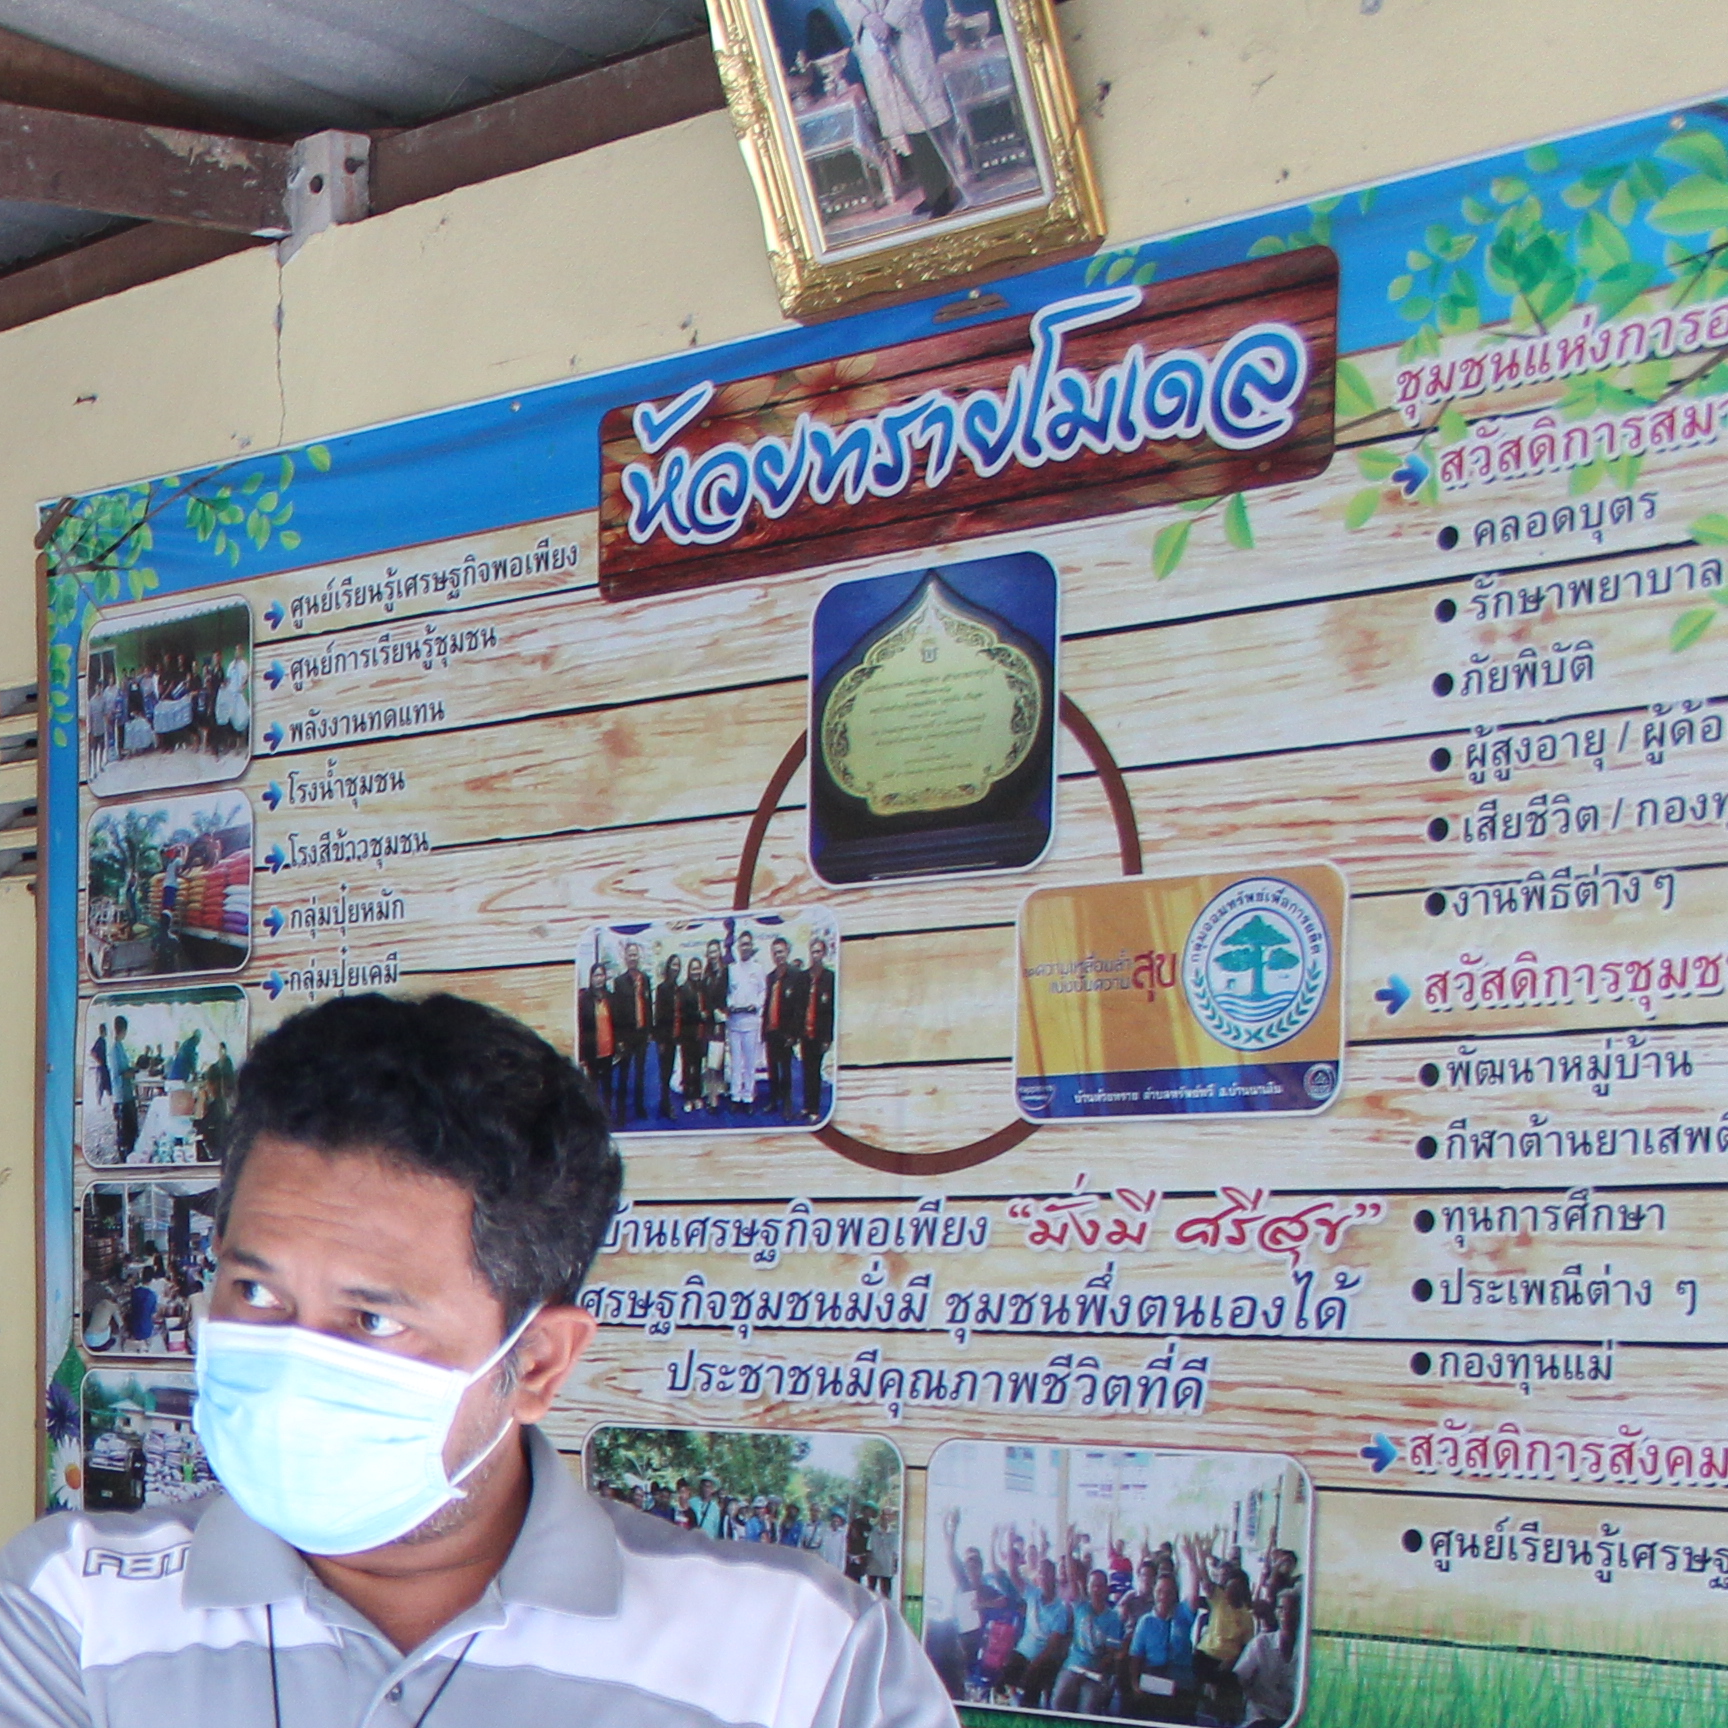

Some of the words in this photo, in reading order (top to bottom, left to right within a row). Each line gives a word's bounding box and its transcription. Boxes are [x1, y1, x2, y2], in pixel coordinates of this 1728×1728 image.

[1439, 400, 1728, 484] สวัสดิการสม
[1473, 491, 1658, 549] คลอดบุตร
[290, 537, 579, 630] ศูนย์เรียนรู้เศรษฐกิจพอเพียง
[1470, 557, 1722, 622] รักษาพยาบาล
[290, 624, 497, 691] ศูนย์การเรียนรู้ชุมชน
[1460, 639, 1594, 697] ภัยพิบัติ
[289, 700, 445, 744] พลังงานทดแทน
[1465, 723, 1605, 785] ผู้สูงอายุ
[287, 758, 405, 809] โรงน้ำชุมชน
[288, 828, 430, 869] โรงสีข้าวชุมชน
[1464, 795, 1599, 844] เสียชีวิต
[290, 882, 405, 939] กลุ่มปุ๋ยหมัก
[1452, 866, 1640, 917] งานพิธีต่าง
[289, 945, 399, 1001] กลุ่มปุ๋ยเคมี
[1425, 951, 1728, 1013] สวัสดิการชุมช
[1447, 1036, 1692, 1097] พัฒนาหมู่บ้าน
[1443, 1189, 1665, 1248] ทุนการศึกษา
[945, 1261, 1360, 1344] ชุมชนพึ่งตนเองได้
[1440, 1264, 1652, 1307] ประเพณีต่าง
[668, 1342, 1208, 1419] ประชาชนมีคุณภาพชีวิตที่ดี
[1438, 1340, 1613, 1395] กองทุนแม่
[1410, 1419, 1728, 1478] สวัสดิการสังคม
